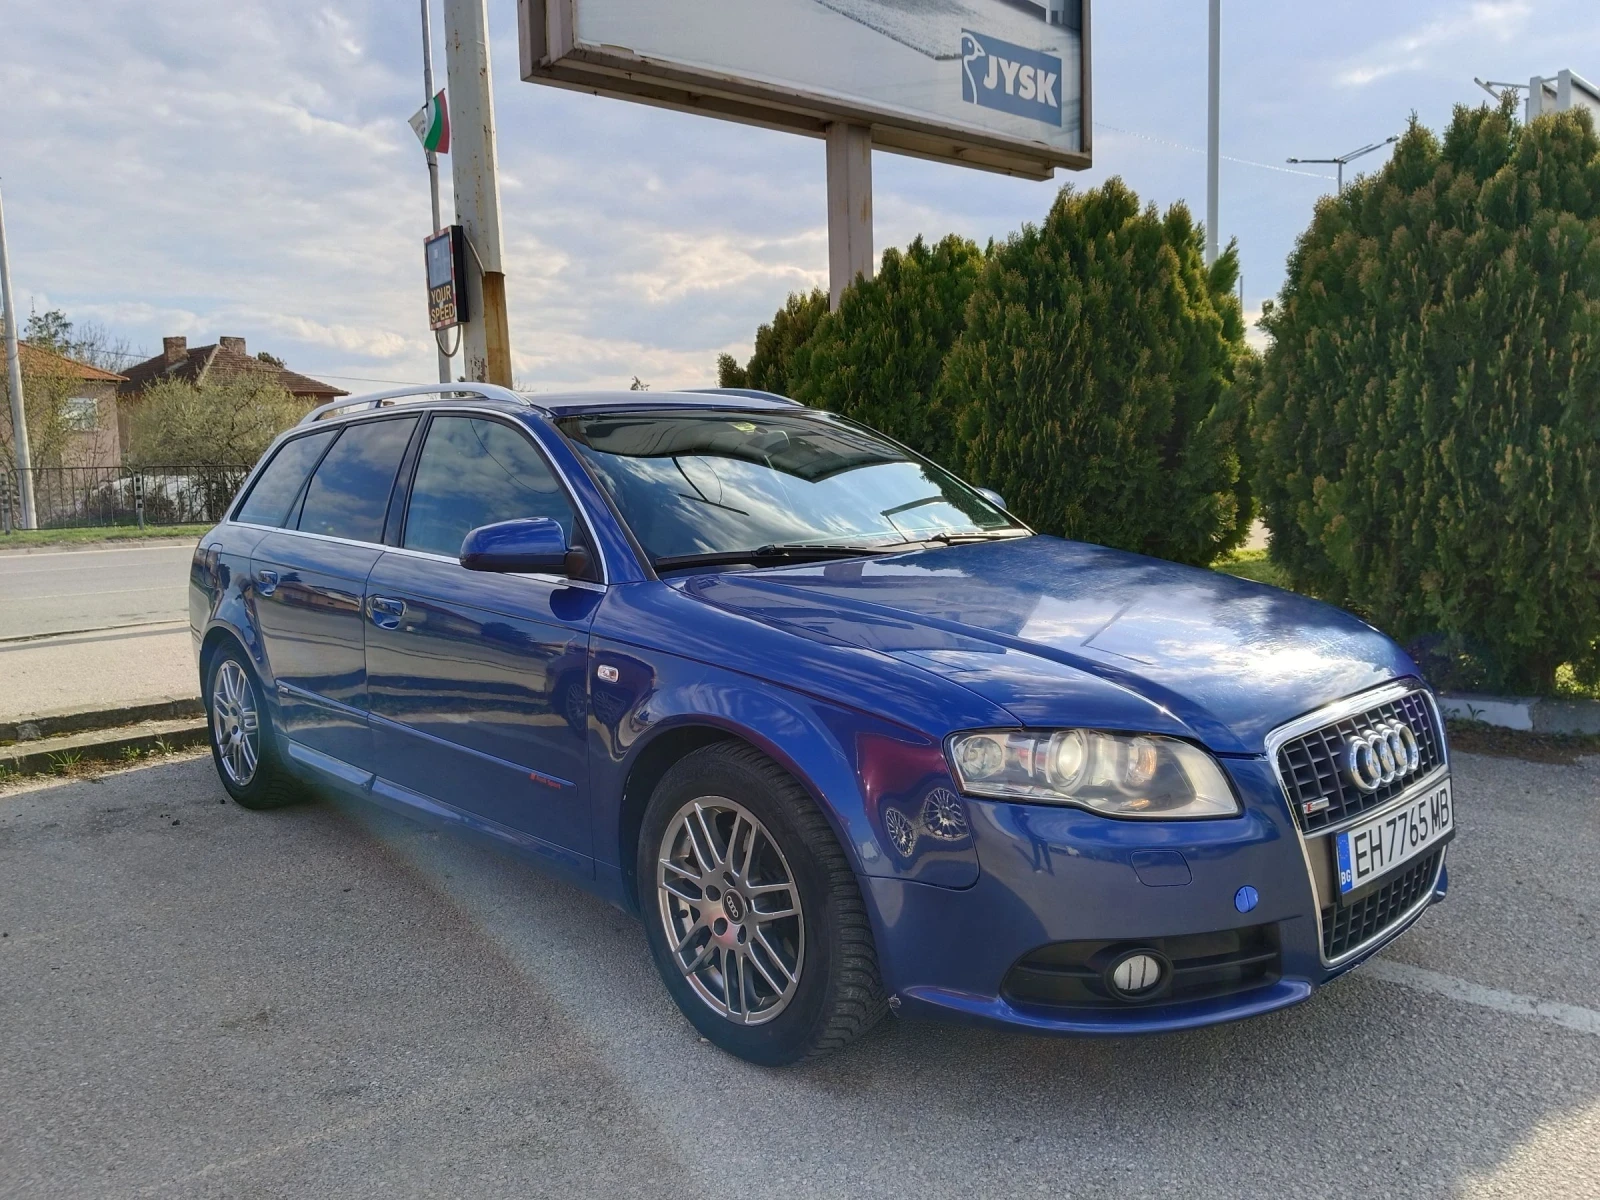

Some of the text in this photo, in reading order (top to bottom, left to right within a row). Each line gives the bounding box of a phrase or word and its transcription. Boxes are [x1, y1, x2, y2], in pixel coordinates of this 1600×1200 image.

[983, 54, 1058, 108] JYSK
[431, 285, 452, 305] YOUR
[431, 303, 454, 323] SPEED
[1341, 870, 1351, 885] BG
